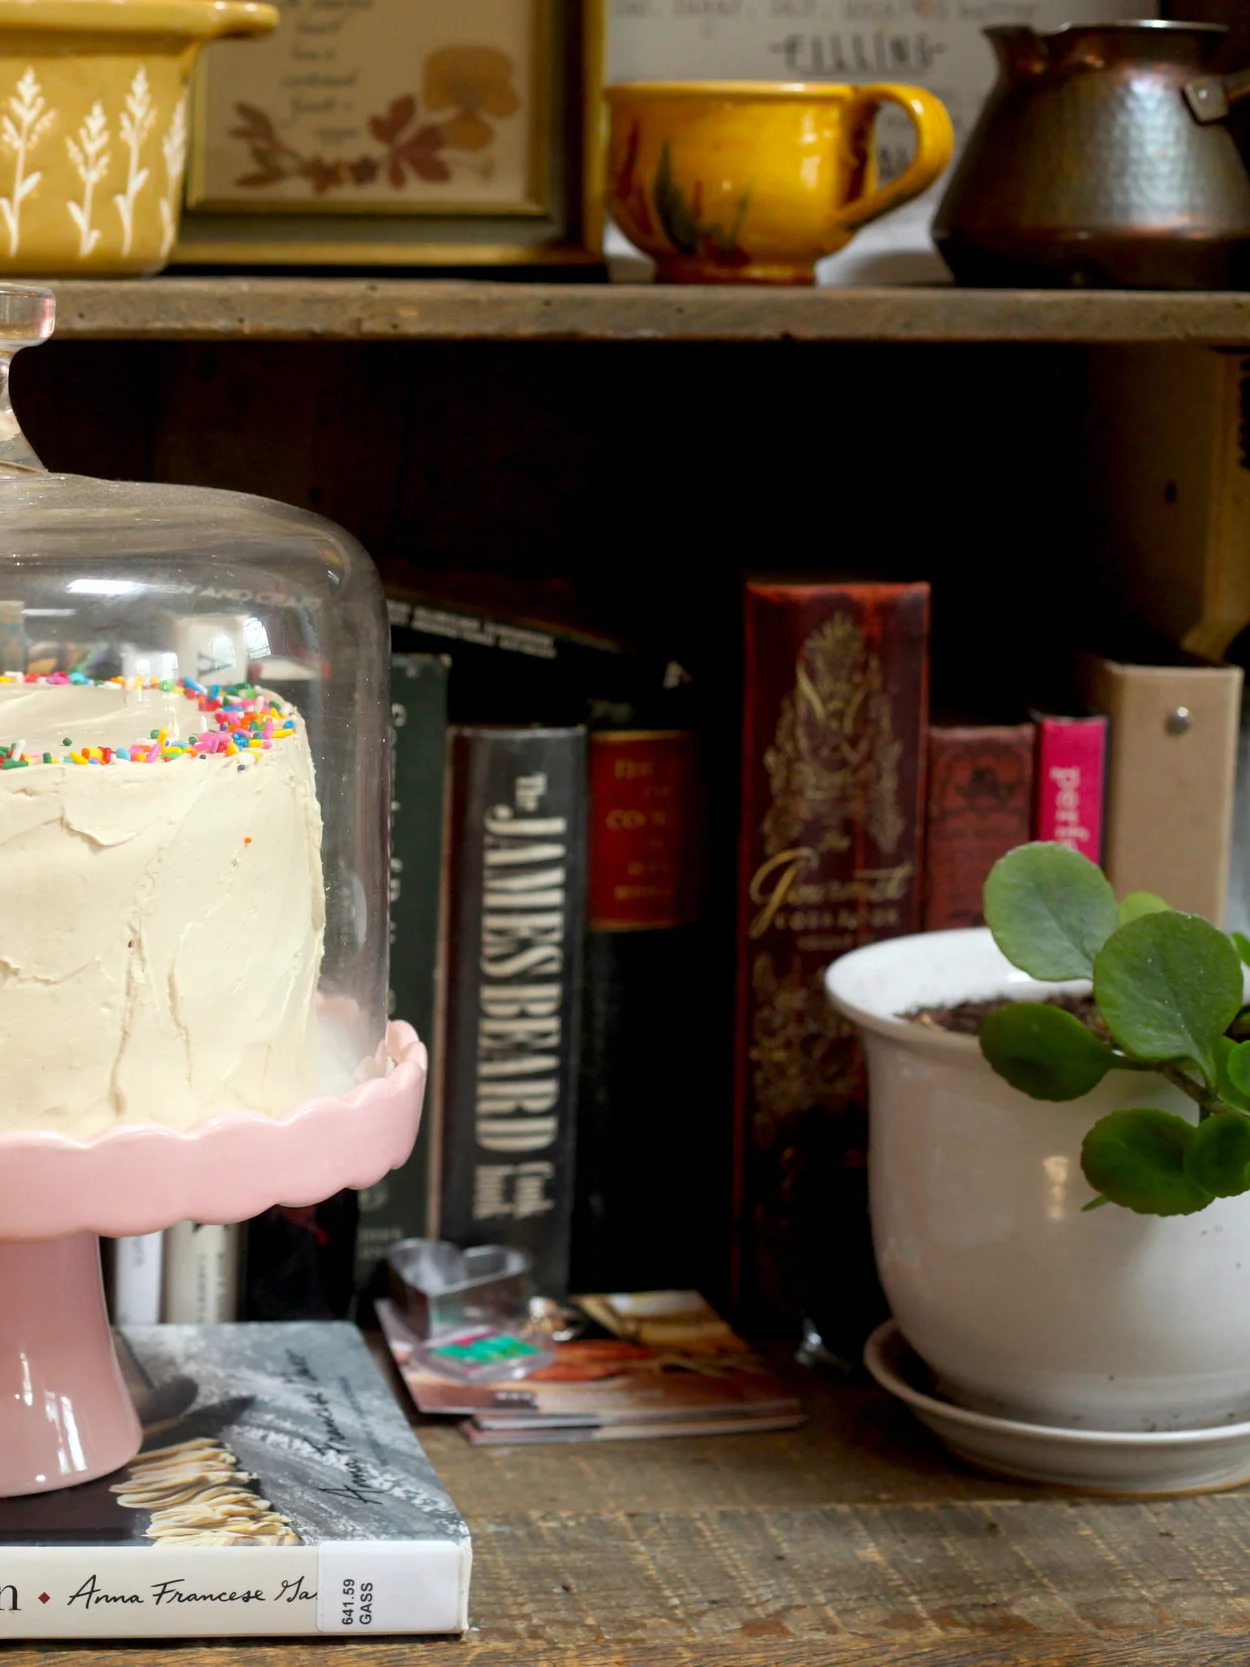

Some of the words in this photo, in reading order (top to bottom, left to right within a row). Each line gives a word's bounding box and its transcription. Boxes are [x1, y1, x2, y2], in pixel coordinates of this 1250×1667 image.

[481, 804, 566, 977] JAMES
[475, 983, 562, 1151] BEARD
[66, 1573, 145, 1610] Anna
[150, 1578, 266, 1606] Francese
[273, 1575, 318, 1604] Ga
[341, 1578, 355, 1626] 641.59
[359, 1582, 373, 1625] GASS
